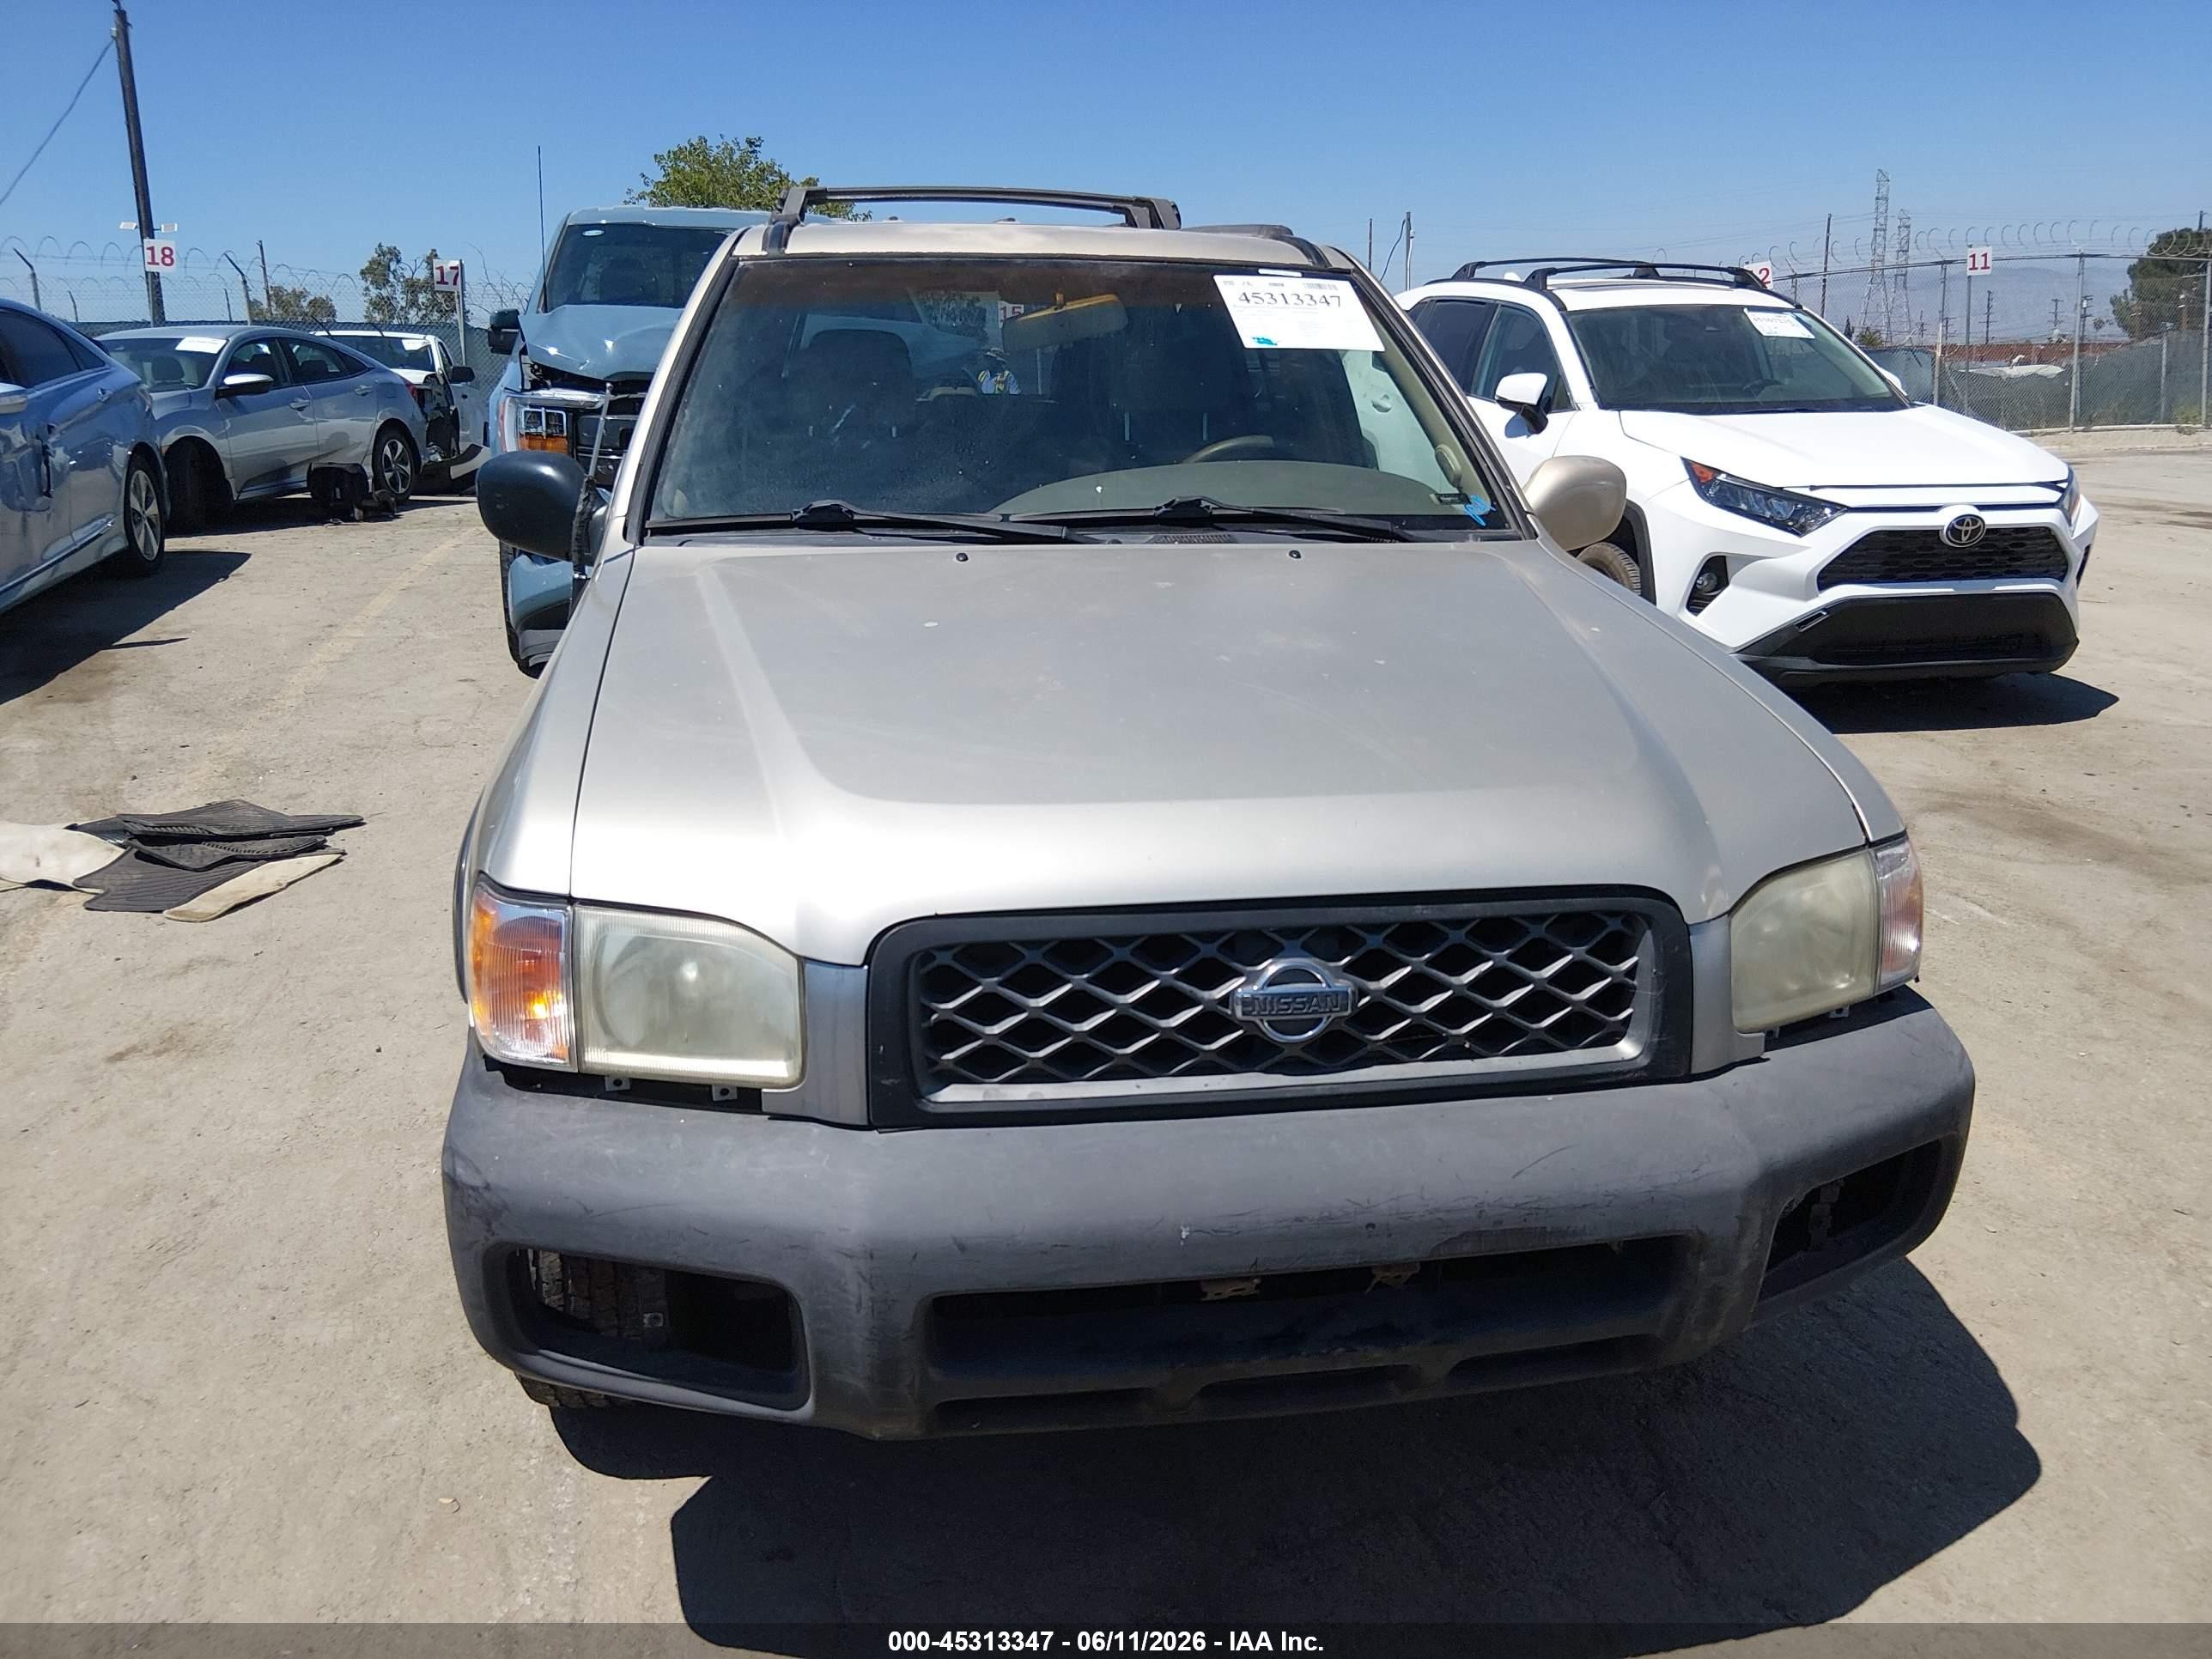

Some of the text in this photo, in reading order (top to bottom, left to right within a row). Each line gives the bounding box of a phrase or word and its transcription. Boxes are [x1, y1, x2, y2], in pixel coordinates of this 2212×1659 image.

[146, 246, 174, 267] 18
[1968, 252, 1990, 270] 11
[435, 265, 459, 286] 17
[1758, 267, 1771, 286] 2
[1237, 291, 1341, 308] 45313347
[1000, 305, 1022, 323] 15
[1251, 993, 1340, 1015] NISSAN
